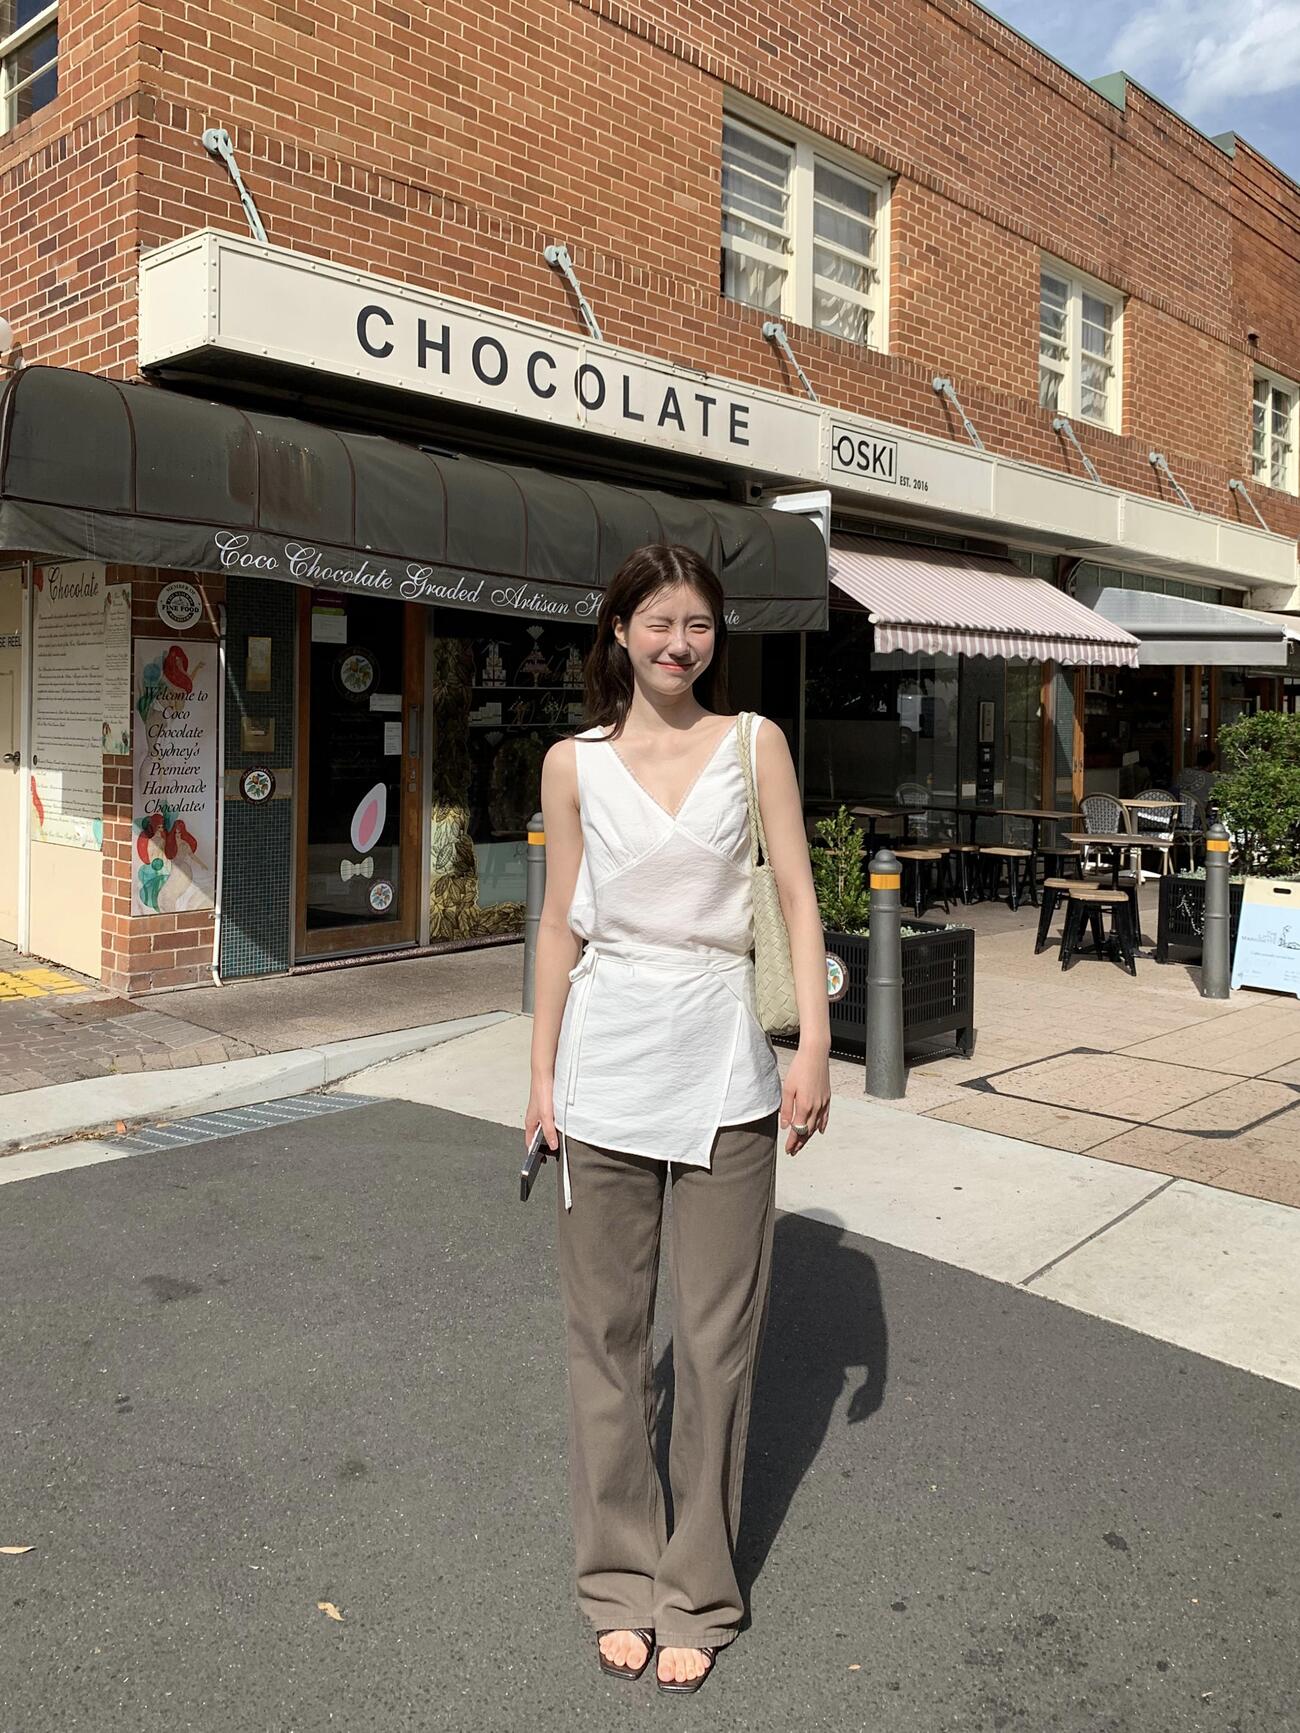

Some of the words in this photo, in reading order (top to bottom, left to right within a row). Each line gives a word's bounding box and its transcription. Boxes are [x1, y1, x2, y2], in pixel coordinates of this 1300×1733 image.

[357, 304, 750, 447] CHOCOLATE
[836, 435, 894, 478] OSKI
[899, 475, 911, 488] EST.
[913, 479, 929, 492] 2016
[214, 531, 279, 568] Coco
[284, 543, 393, 590] Chocolate
[399, 563, 485, 599] Graded
[491, 583, 570, 615] Artisan
[48, 566, 99, 602] Chocolate
[162, 604, 179, 612] FINE
[145, 686, 195, 702] Welcome
[197, 690, 209, 702] to
[162, 705, 191, 720] Coco
[148, 723, 204, 739] Chocolate
[150, 742, 200, 760] Sydney's
[150, 762, 201, 776] Premiere
[142, 779, 207, 796] Handmade
[144, 797, 206, 814] Chocolates
